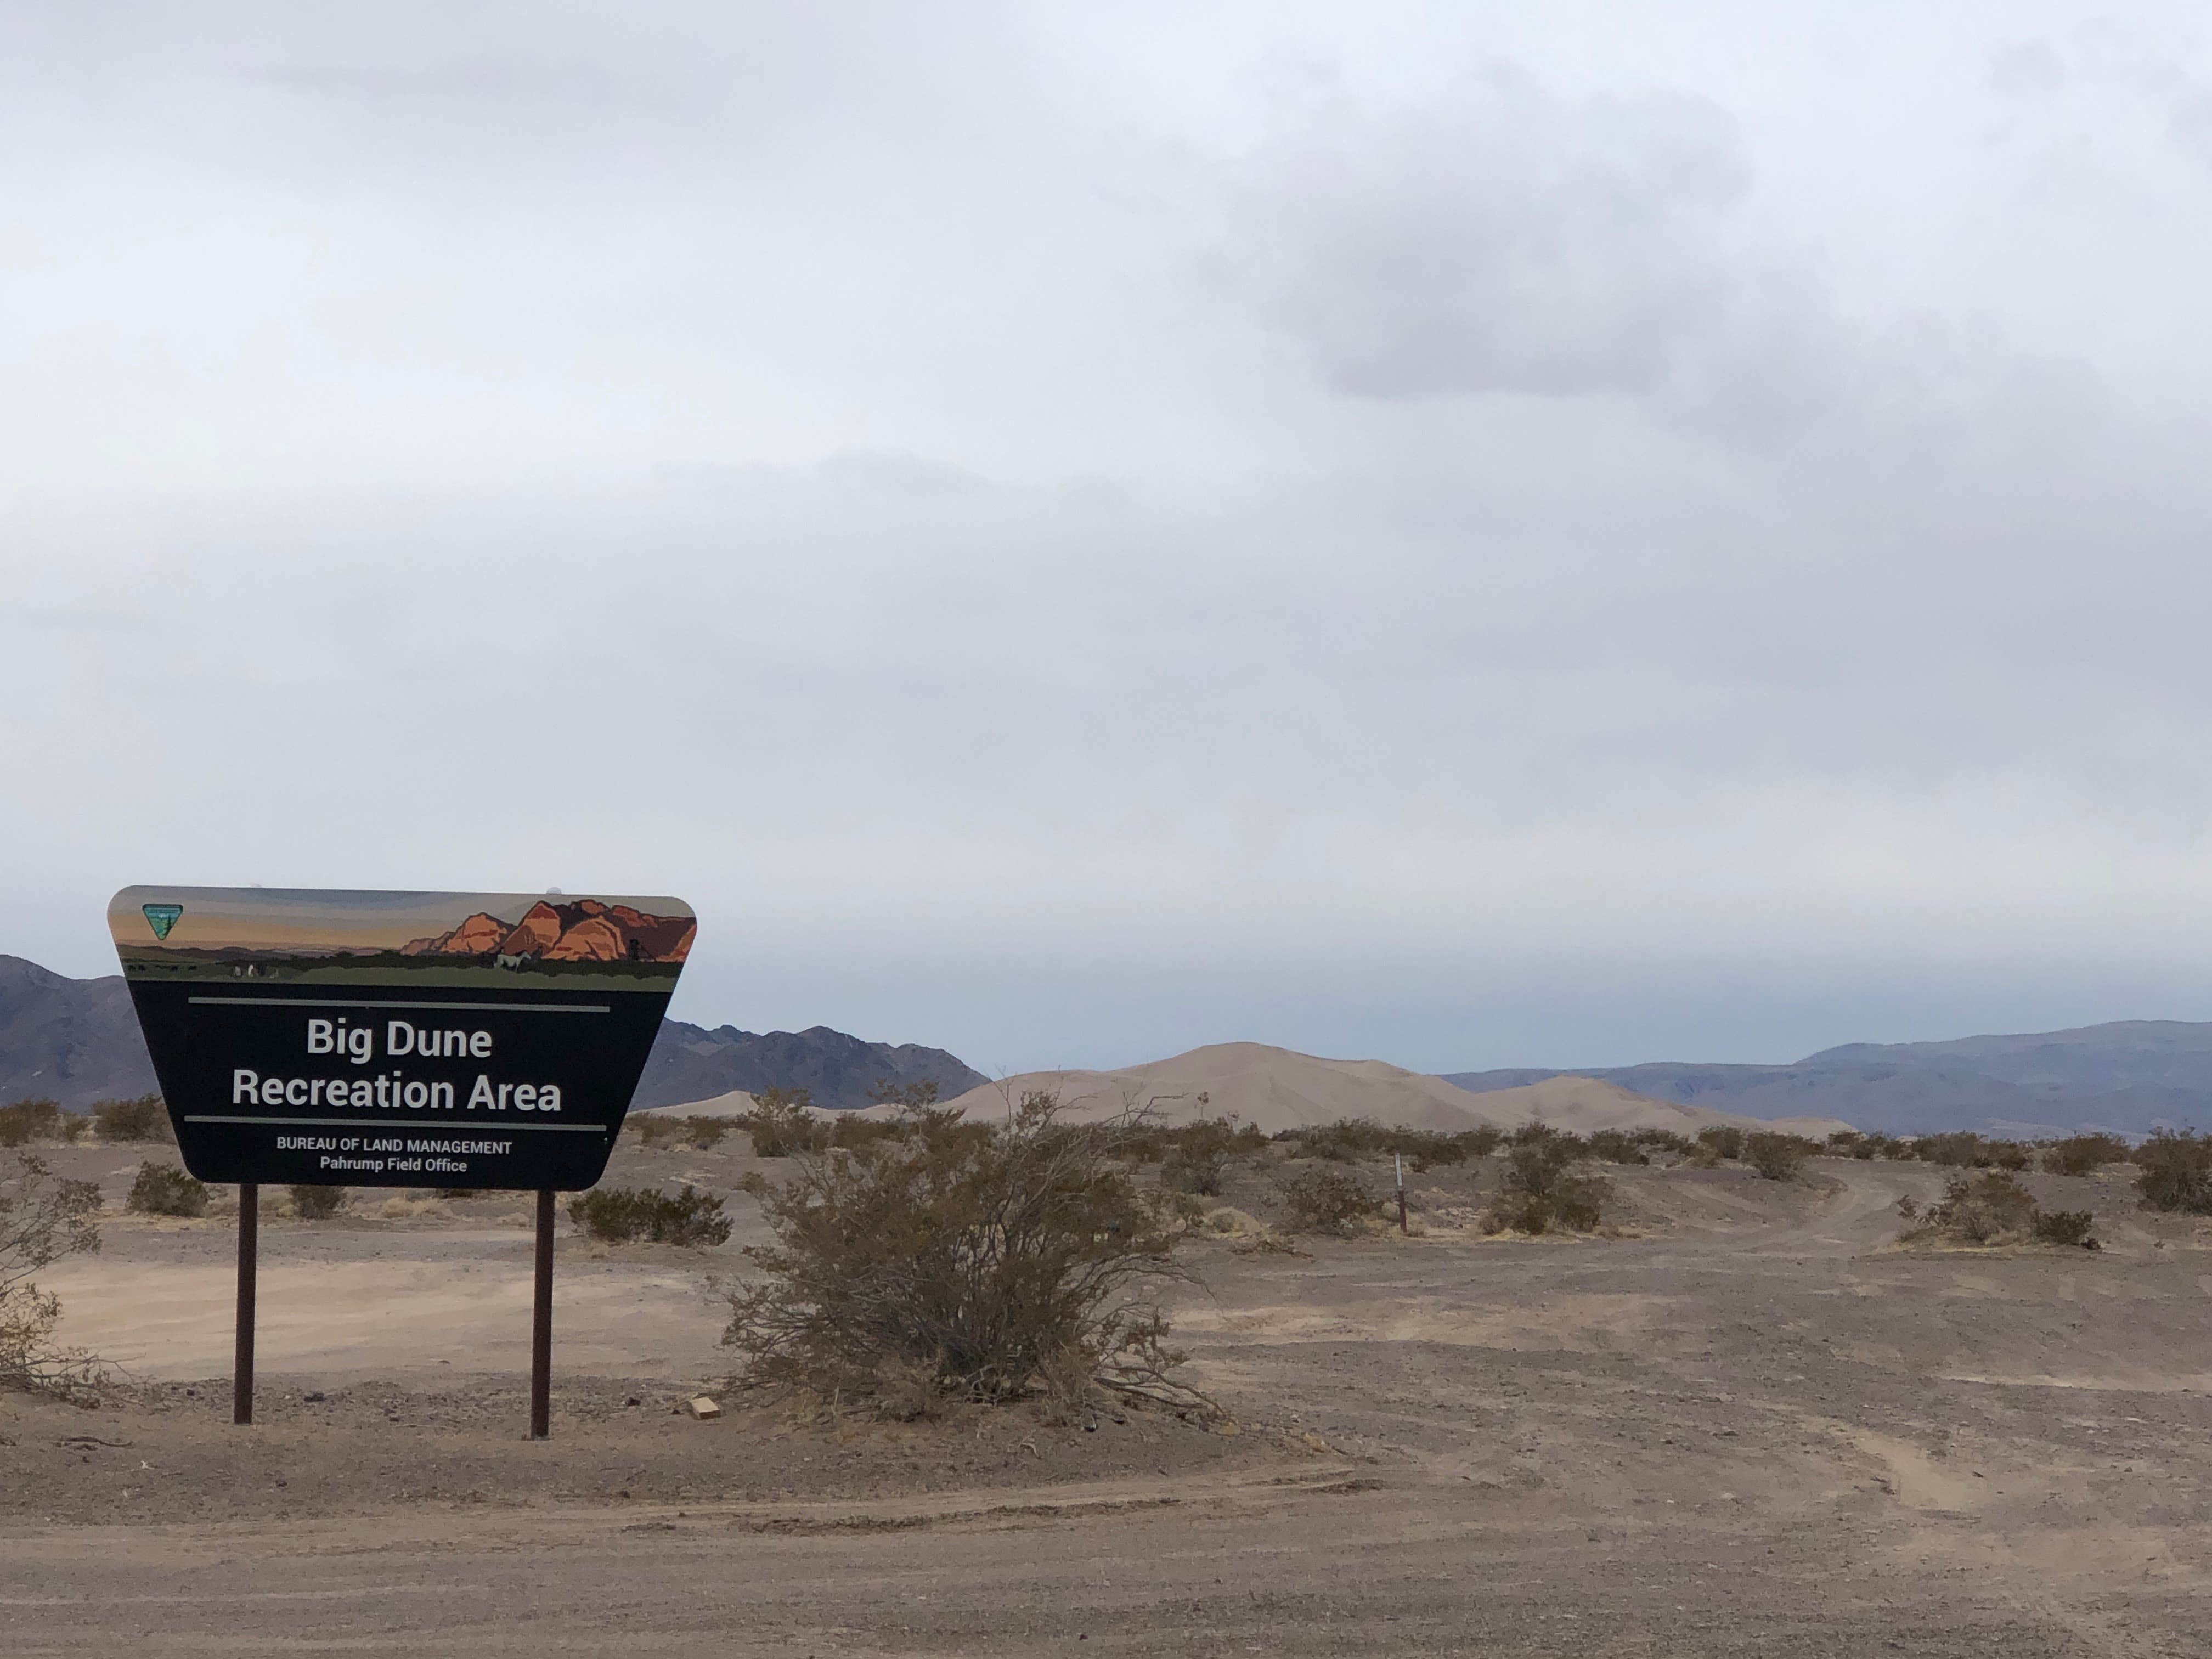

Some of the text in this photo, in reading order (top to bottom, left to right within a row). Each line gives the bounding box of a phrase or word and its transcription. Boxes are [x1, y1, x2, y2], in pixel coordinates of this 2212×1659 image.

[307, 1018, 492, 1065] Big Dune
[233, 1069, 561, 1111] Recreation Area
[276, 1137, 512, 1154] BUREAU OF LAND MANAGEMENT
[320, 1156, 467, 1173] Pahrump Field Office
